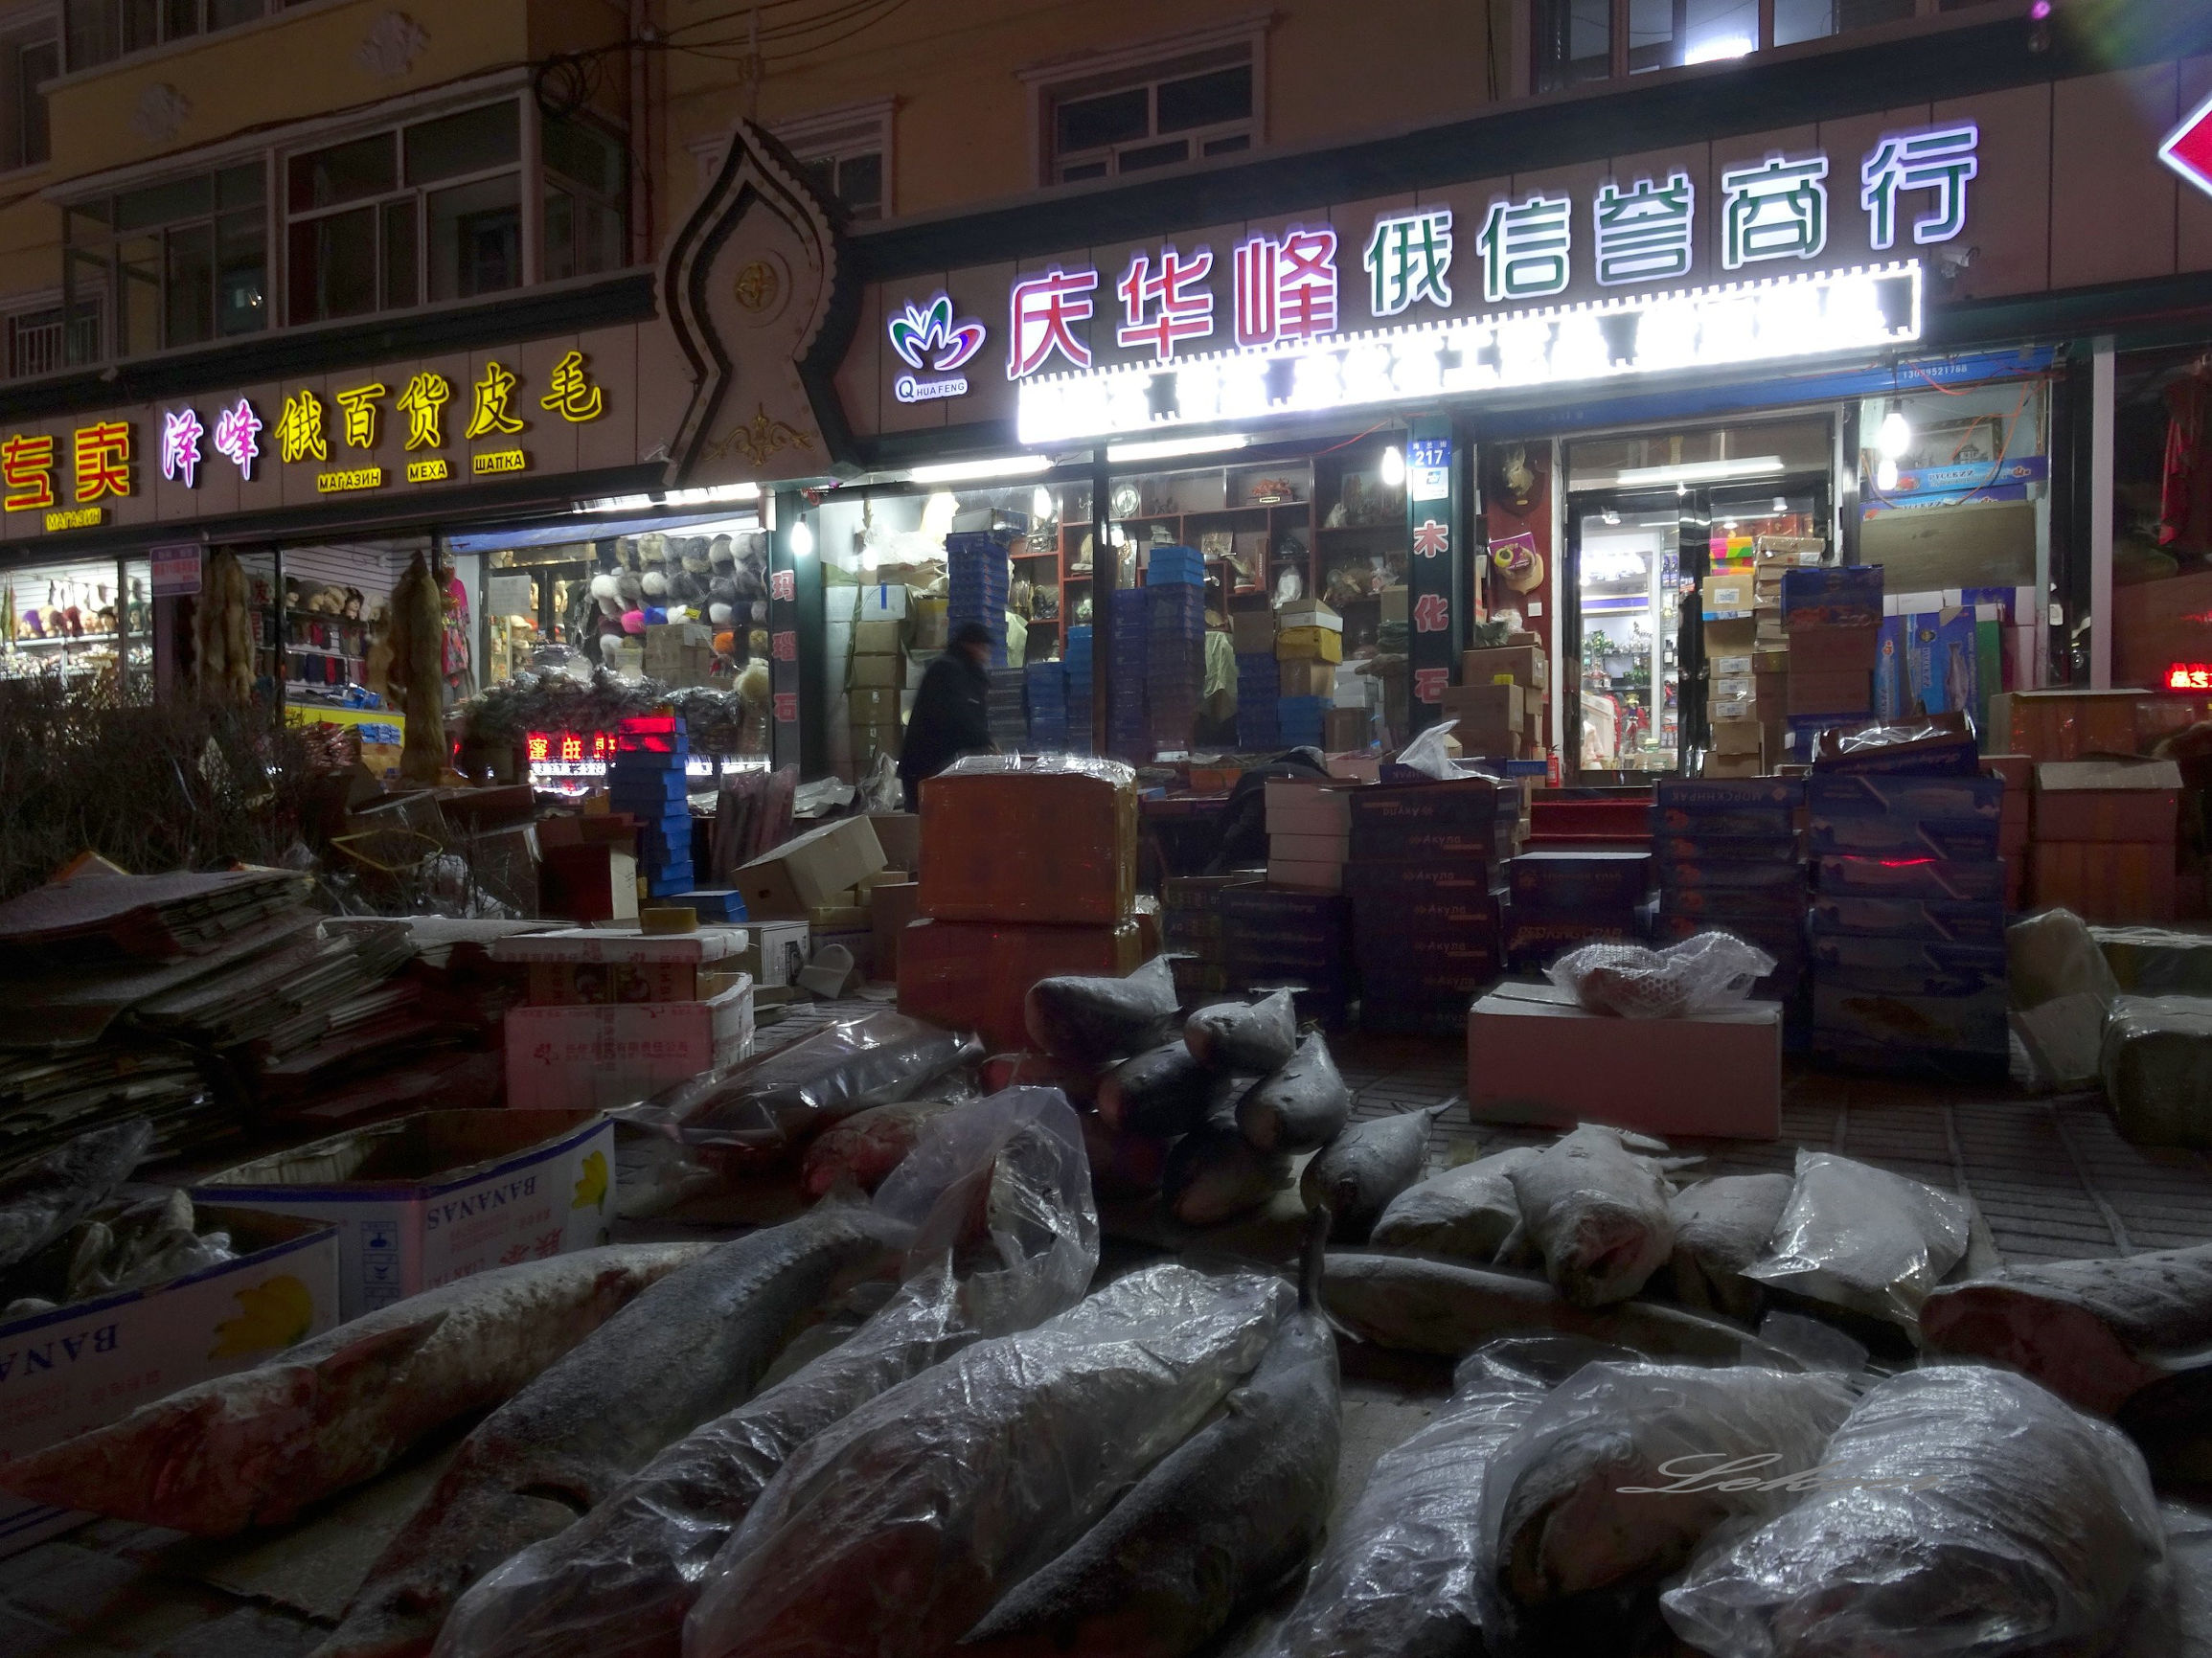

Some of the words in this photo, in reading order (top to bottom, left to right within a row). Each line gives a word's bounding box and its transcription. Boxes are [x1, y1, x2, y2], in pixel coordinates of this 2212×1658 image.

[1006, 122, 1980, 381] 庆华峰俄信誉商行
[3, 421, 130, 511] 专卖
[318, 468, 381, 492] МАГАЗИН
[407, 460, 447, 483] МЕХА
[473, 450, 525, 474] ШАПКА
[1415, 449, 1444, 466] 217
[46, 508, 102, 532] МАГАЗИН
[771, 568, 798, 723] 玛瑙石
[1413, 519, 1449, 704] 木化石
[427, 1176, 536, 1231] BANANAS
